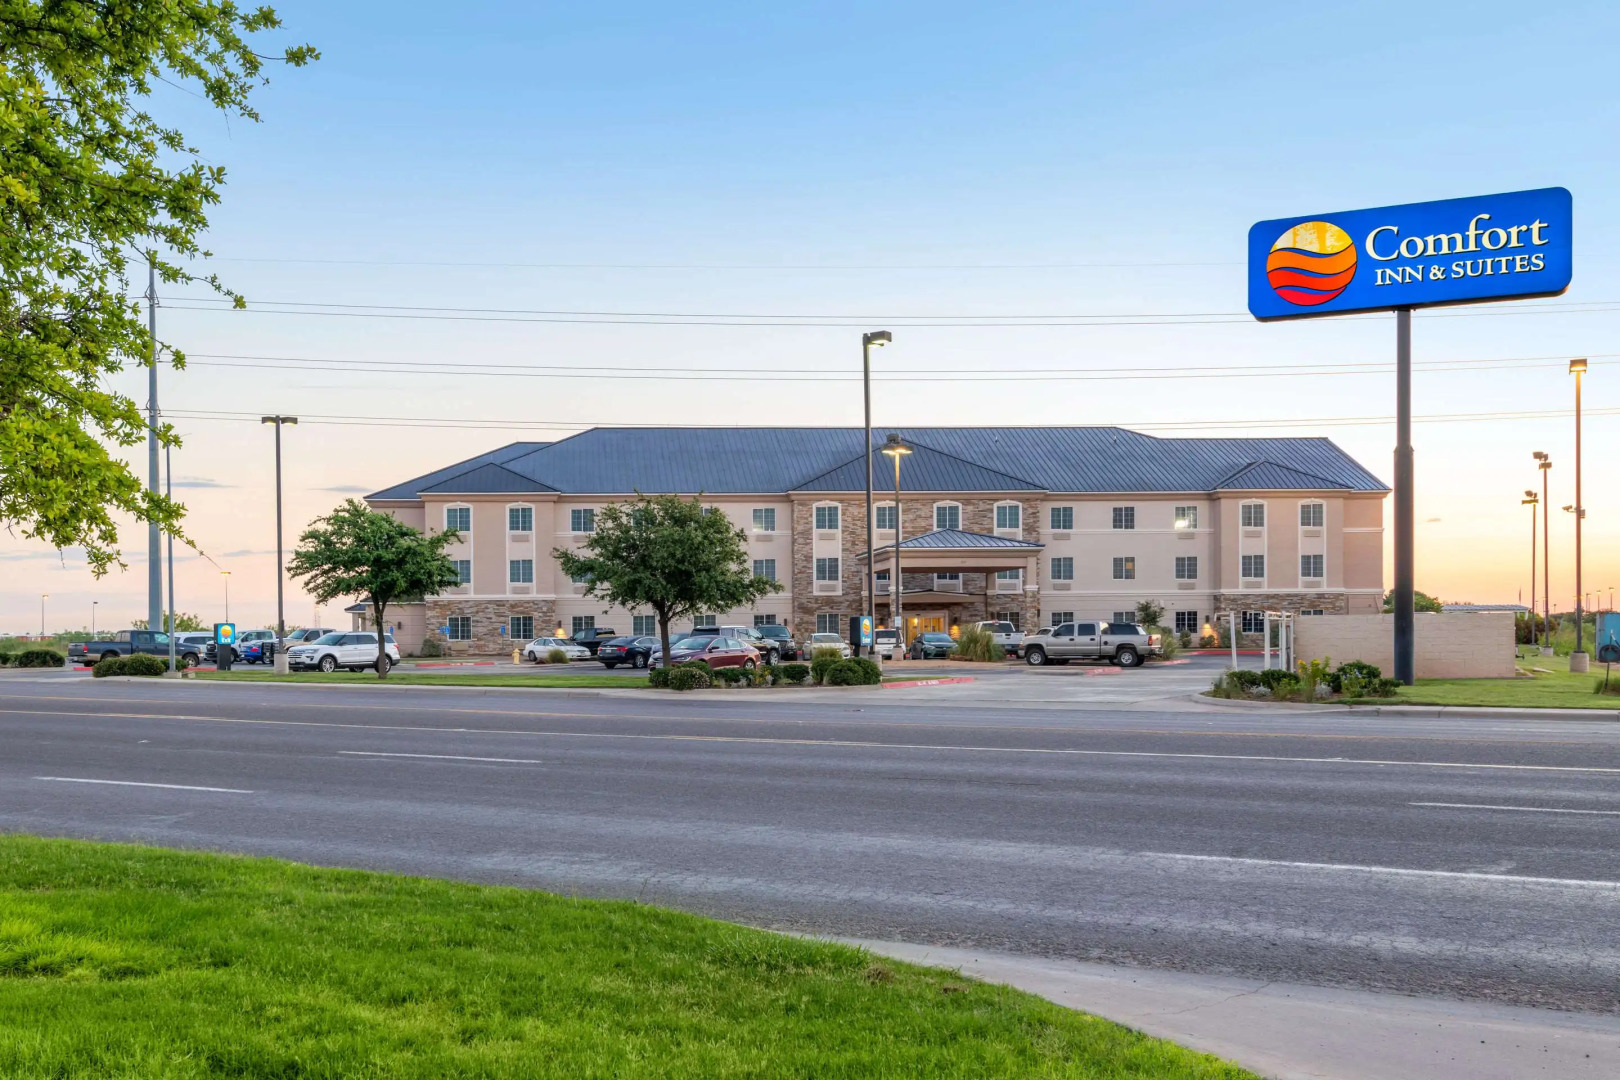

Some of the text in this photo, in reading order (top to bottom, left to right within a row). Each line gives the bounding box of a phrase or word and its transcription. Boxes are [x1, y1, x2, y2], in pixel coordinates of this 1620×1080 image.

[1365, 213, 1549, 261] Comfort
[1374, 253, 1545, 286] INN & SUITES
